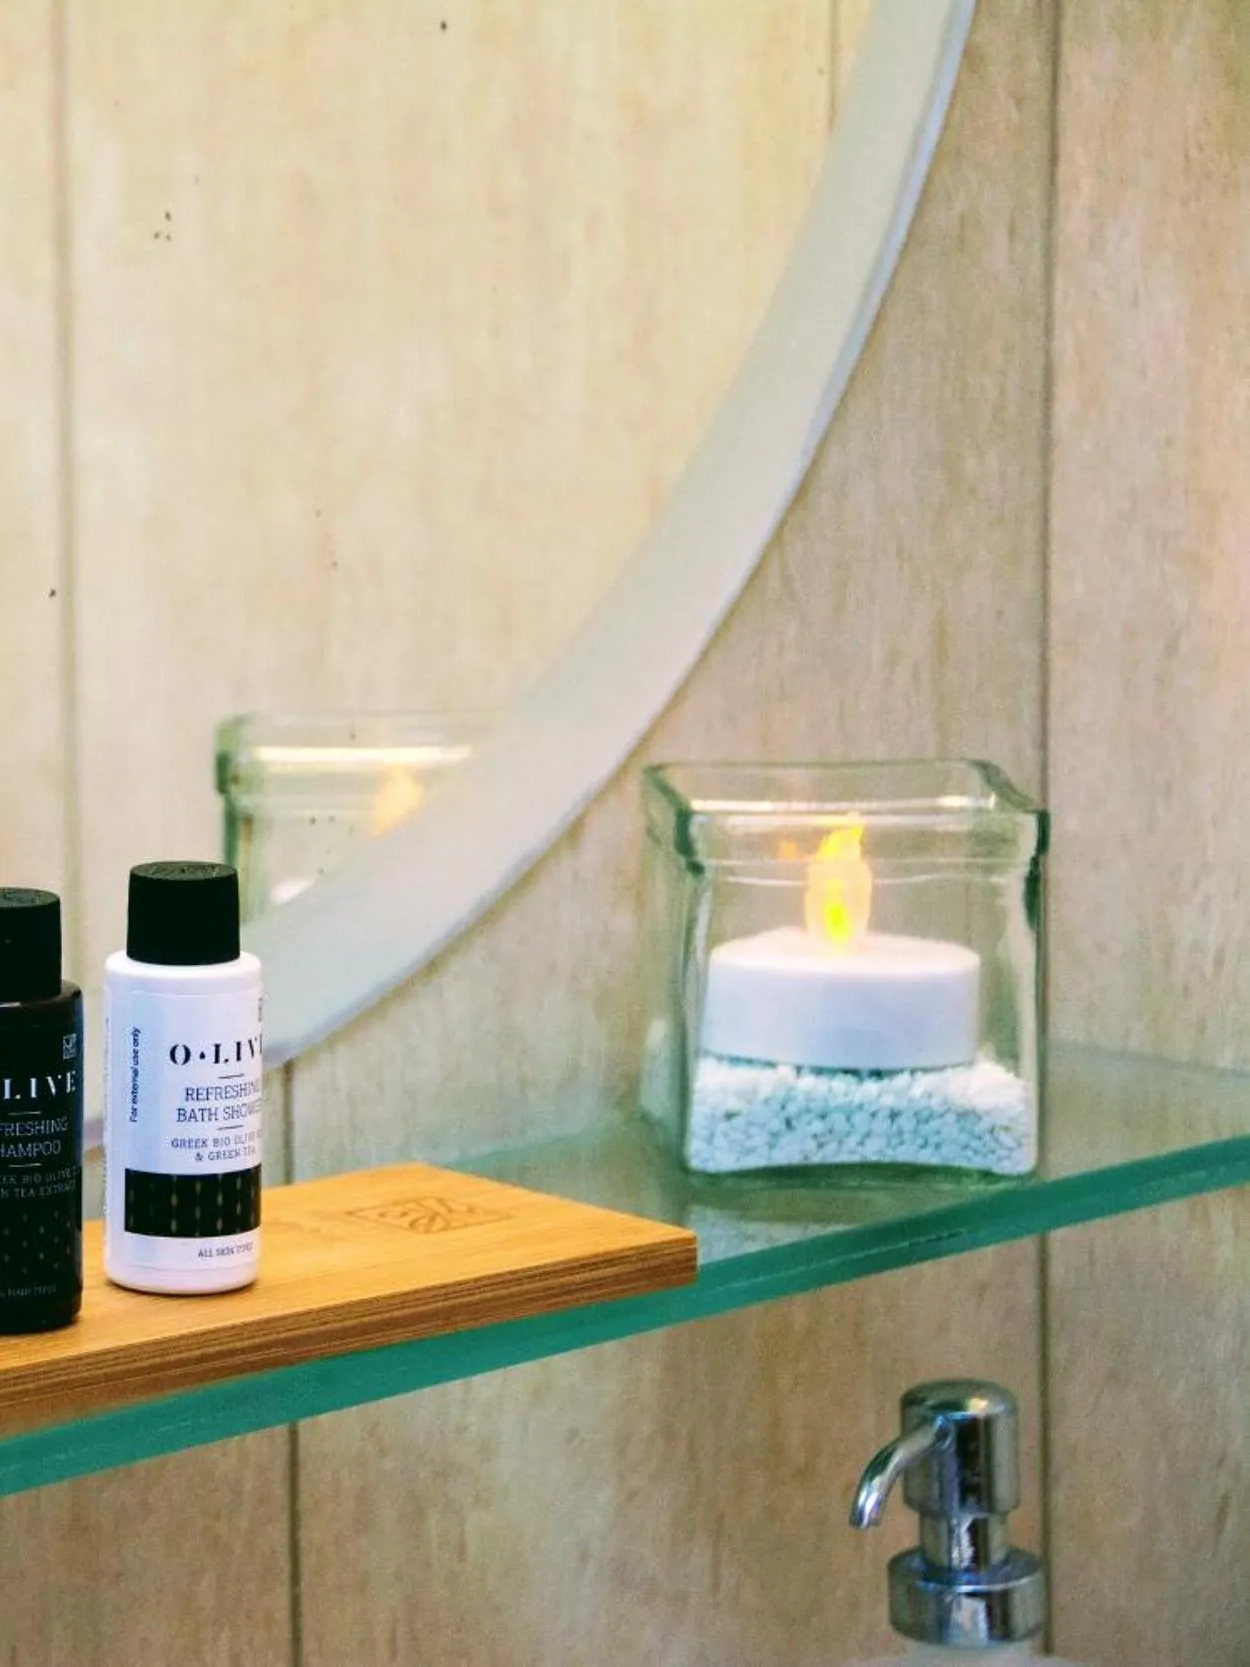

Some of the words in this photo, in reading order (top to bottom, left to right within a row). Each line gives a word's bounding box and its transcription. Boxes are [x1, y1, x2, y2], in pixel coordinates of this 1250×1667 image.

[130, 1027, 141, 1048] only
[129, 1106, 138, 1122] For
[176, 1107, 219, 1123] BATH
[171, 1138, 208, 1149] GREEK
[213, 1136, 230, 1147] BIO
[195, 1152, 203, 1161] &
[208, 1149, 241, 1161] GREEN
[198, 1248, 214, 1258] ALL
